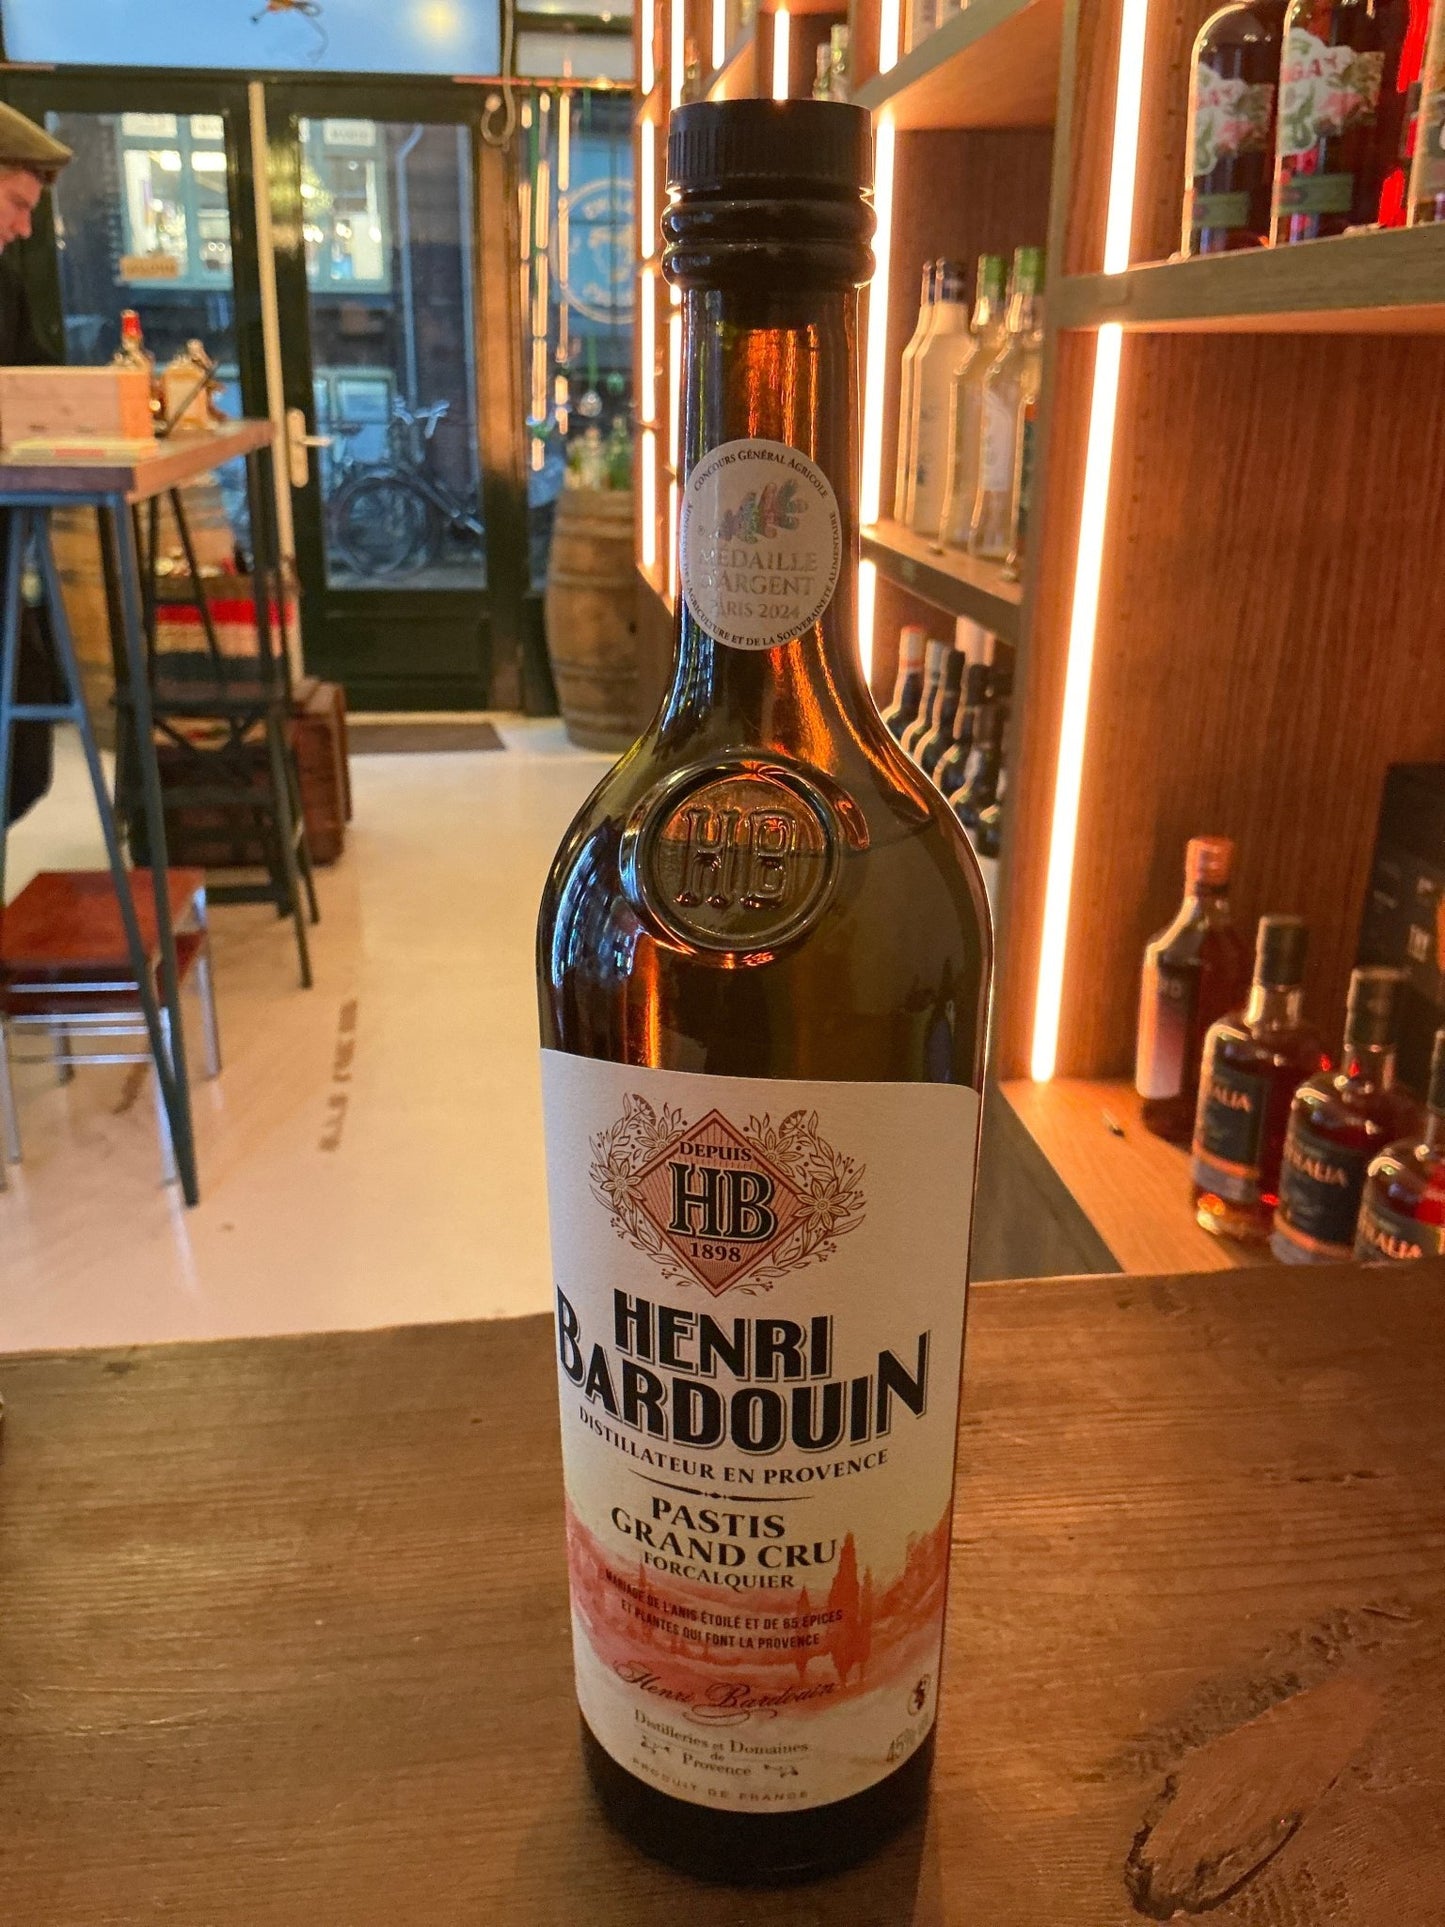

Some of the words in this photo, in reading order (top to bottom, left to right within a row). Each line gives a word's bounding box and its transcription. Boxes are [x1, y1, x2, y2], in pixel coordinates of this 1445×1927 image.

[694, 452, 736, 492] CONCOURS
[738, 449, 786, 465] GÉNÉRAL
[787, 458, 828, 499] AGRICOLE
[760, 603, 800, 620] 2024
[732, 636, 744, 645] ET
[746, 638, 760, 646] DE
[762, 635, 775, 645] LA
[674, 805, 797, 908] HB
[678, 1140, 752, 1162] DEPUIS
[666, 1160, 779, 1244] HB
[689, 1241, 741, 1264] 1898
[612, 1287, 834, 1384] HENRI
[556, 1283, 932, 1457] BARDOUIN
[579, 1405, 715, 1480] DISTILLATEUR
[724, 1466, 754, 1485] EN
[764, 1449, 889, 1485] PROVENCE
[610, 1506, 746, 1568] GRAND
[757, 1538, 838, 1569] CRU
[651, 1495, 786, 1539] PASTIS
[643, 1550, 796, 1593] FORCALQUIER
[620, 1599, 634, 1615] ET
[634, 1606, 680, 1637] PLANTES
[682, 1625, 702, 1642] QUI
[705, 1632, 737, 1649] FONT
[739, 1636, 754, 1649] LA
[758, 1632, 820, 1650] PROVENCE
[647, 1595, 661, 1610] DE
[663, 1600, 698, 1622] L'ANIS
[700, 1610, 741, 1630] ÉTOILÉ
[745, 1617, 760, 1630] ET
[763, 1617, 778, 1630] DE
[613, 1659, 696, 1704] Henri
[703, 1681, 836, 1710] Bardouin
[634, 1706, 709, 1749] Distilleries
[712, 1741, 724, 1751] et
[729, 1739, 809, 1756] Domaines
[682, 1752, 752, 1777] Provence
[710, 1751, 725, 1762] de
